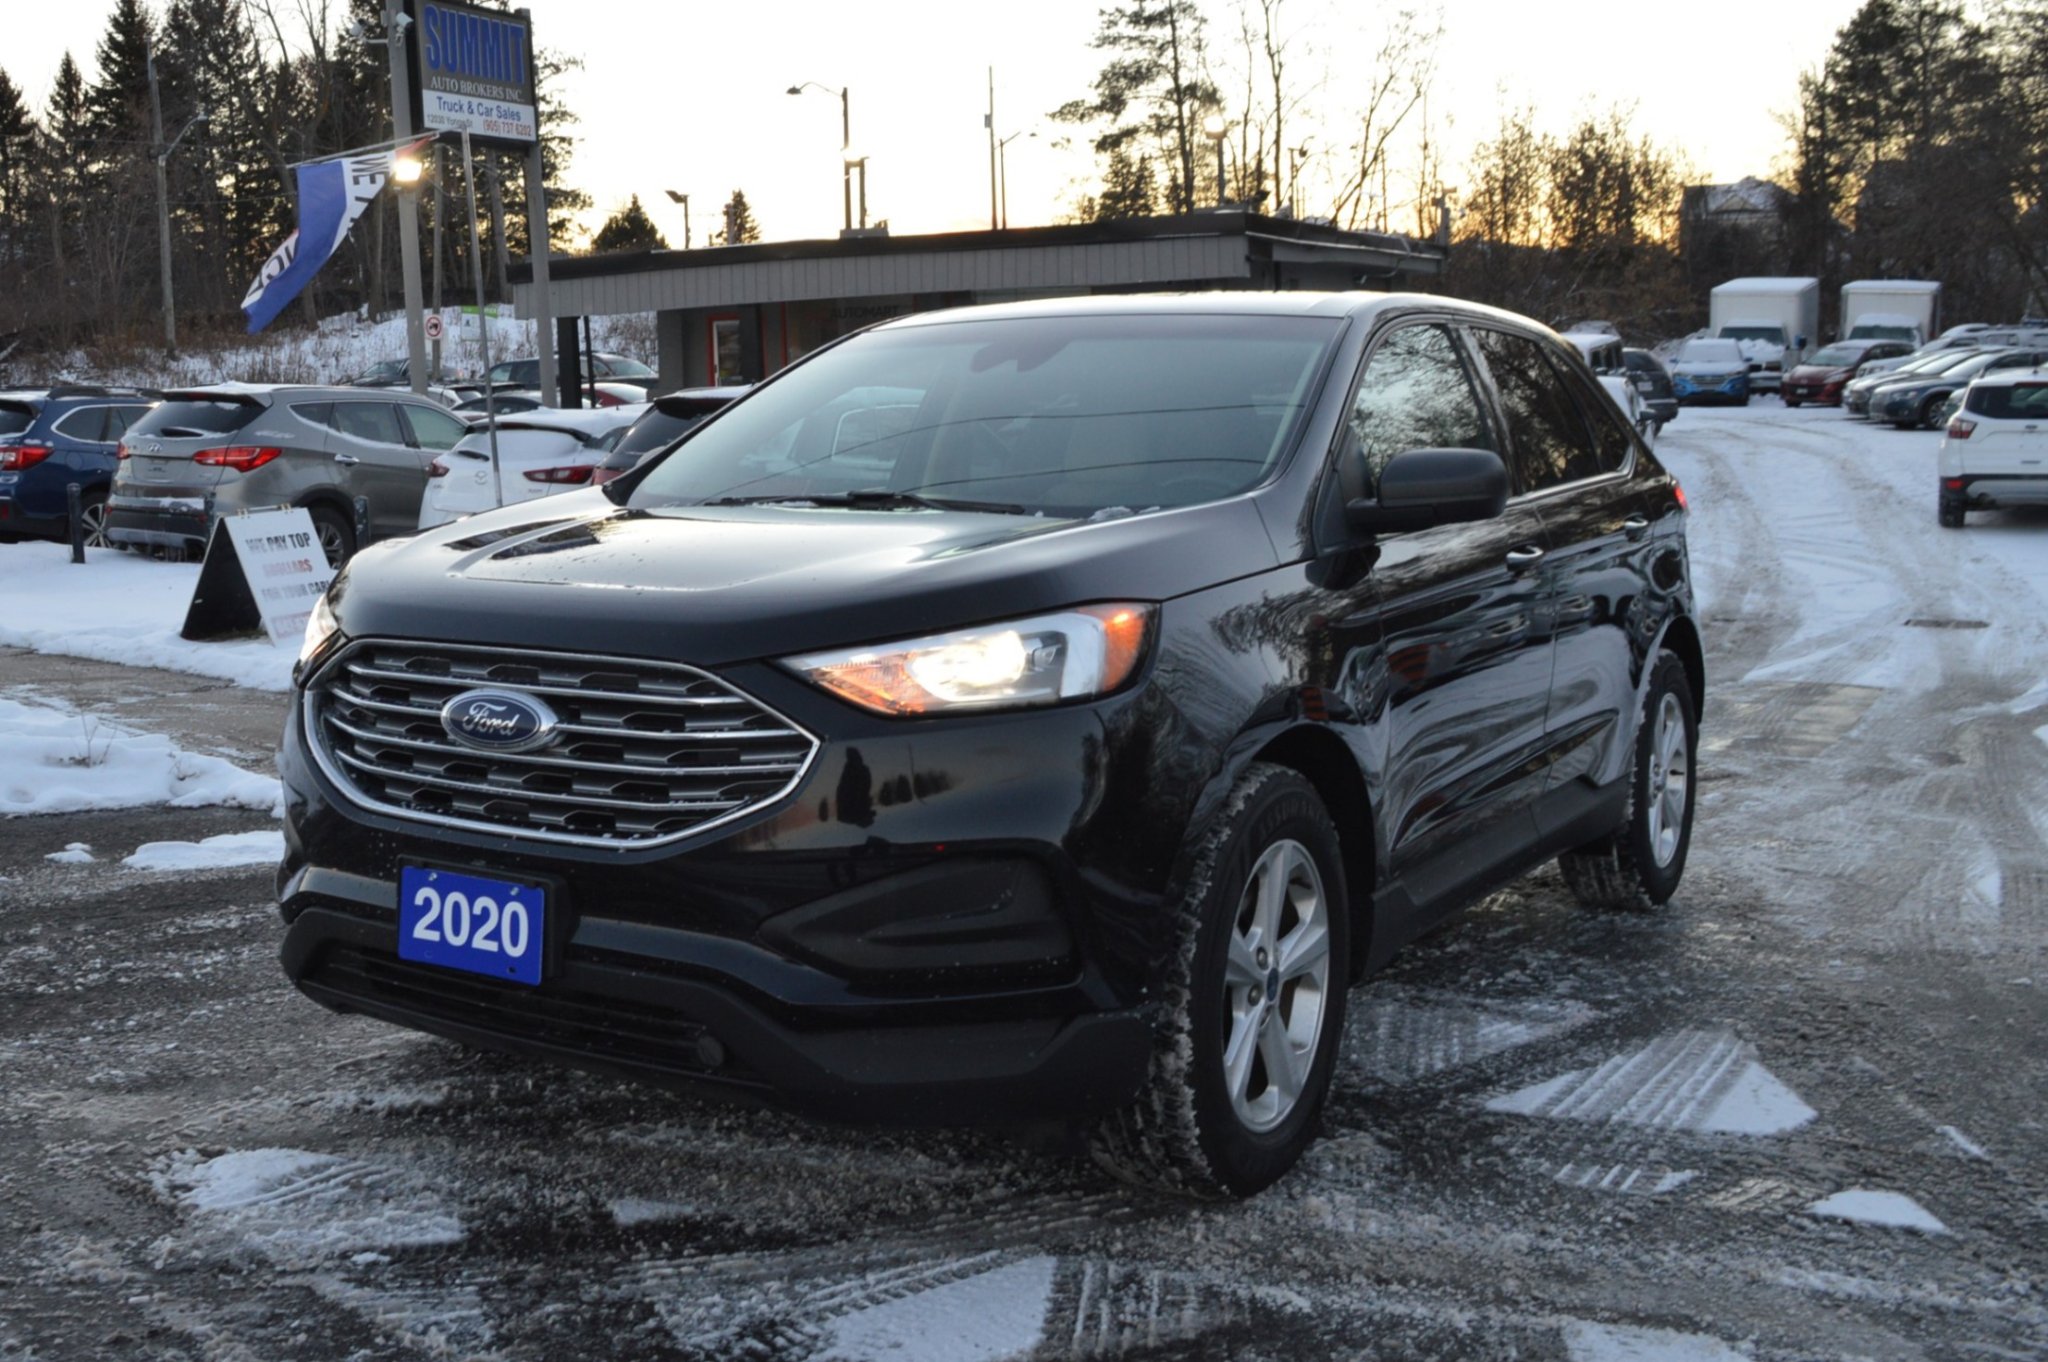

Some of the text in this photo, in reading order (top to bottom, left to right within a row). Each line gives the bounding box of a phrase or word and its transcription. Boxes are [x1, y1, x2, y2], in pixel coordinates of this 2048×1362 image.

[424, 4, 525, 86] SUMMIT
[430, 76, 459, 92] AUTO
[460, 80, 504, 100] BROKERS
[436, 95, 522, 122] Truck & Car Sales
[266, 533, 289, 552] PAY
[288, 532, 311, 549] TOP
[462, 702, 520, 736] Ford
[413, 887, 529, 957] 2020
